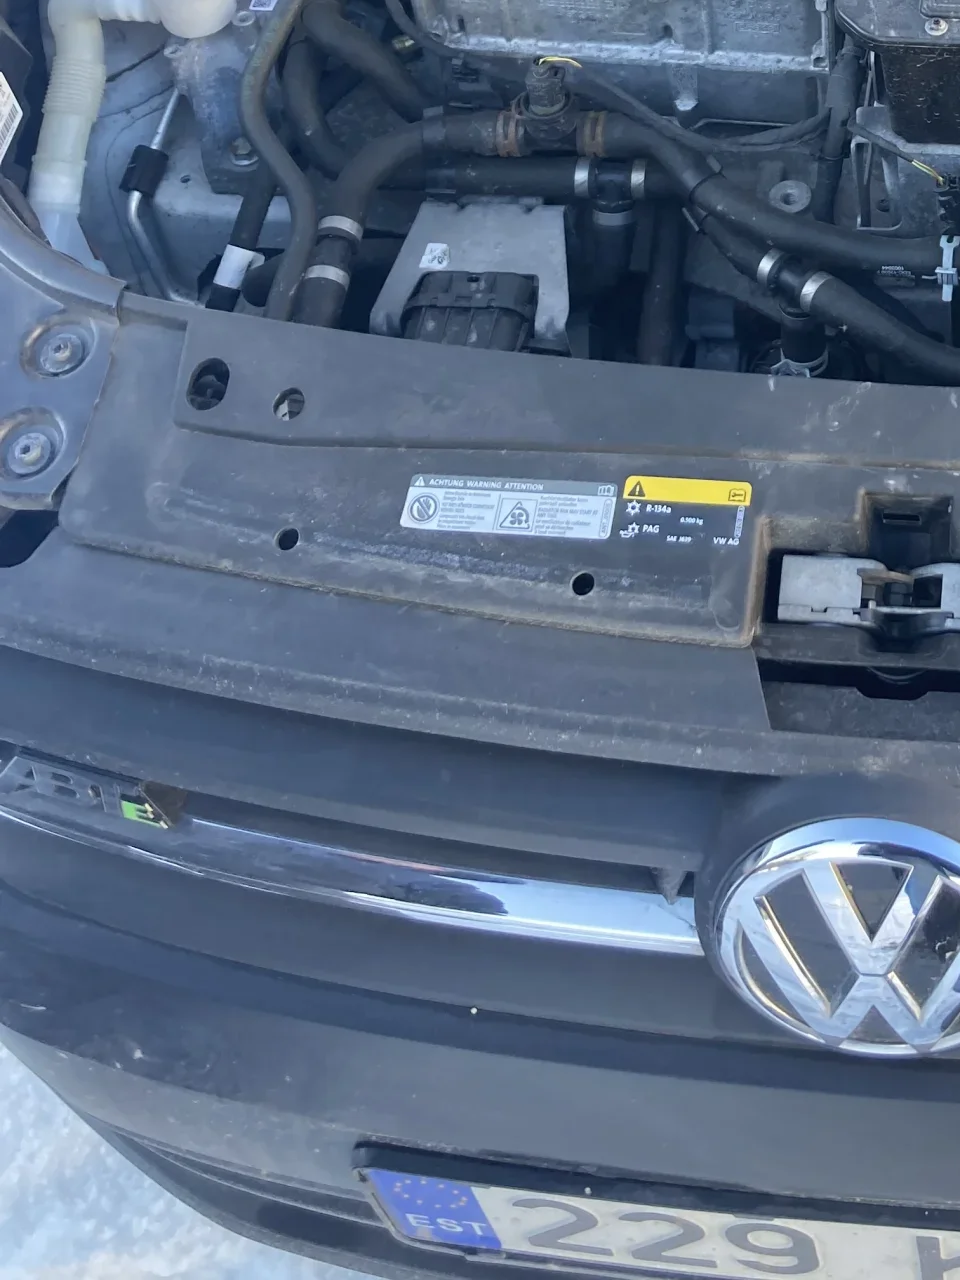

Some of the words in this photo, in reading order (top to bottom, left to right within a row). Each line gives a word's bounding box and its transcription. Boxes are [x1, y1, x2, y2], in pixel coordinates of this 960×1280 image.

[428, 478, 464, 487] ACHTUNG
[466, 480, 502, 489] WARNING
[504, 481, 544, 491] ATTENTION
[646, 504, 672, 513] R-134a
[642, 525, 660, 533] PAG
[713, 537, 726, 545] VW
[727, 538, 739, 546] AG
[406, 1212, 486, 1237] EST
[512, 1198, 822, 1275] 229
